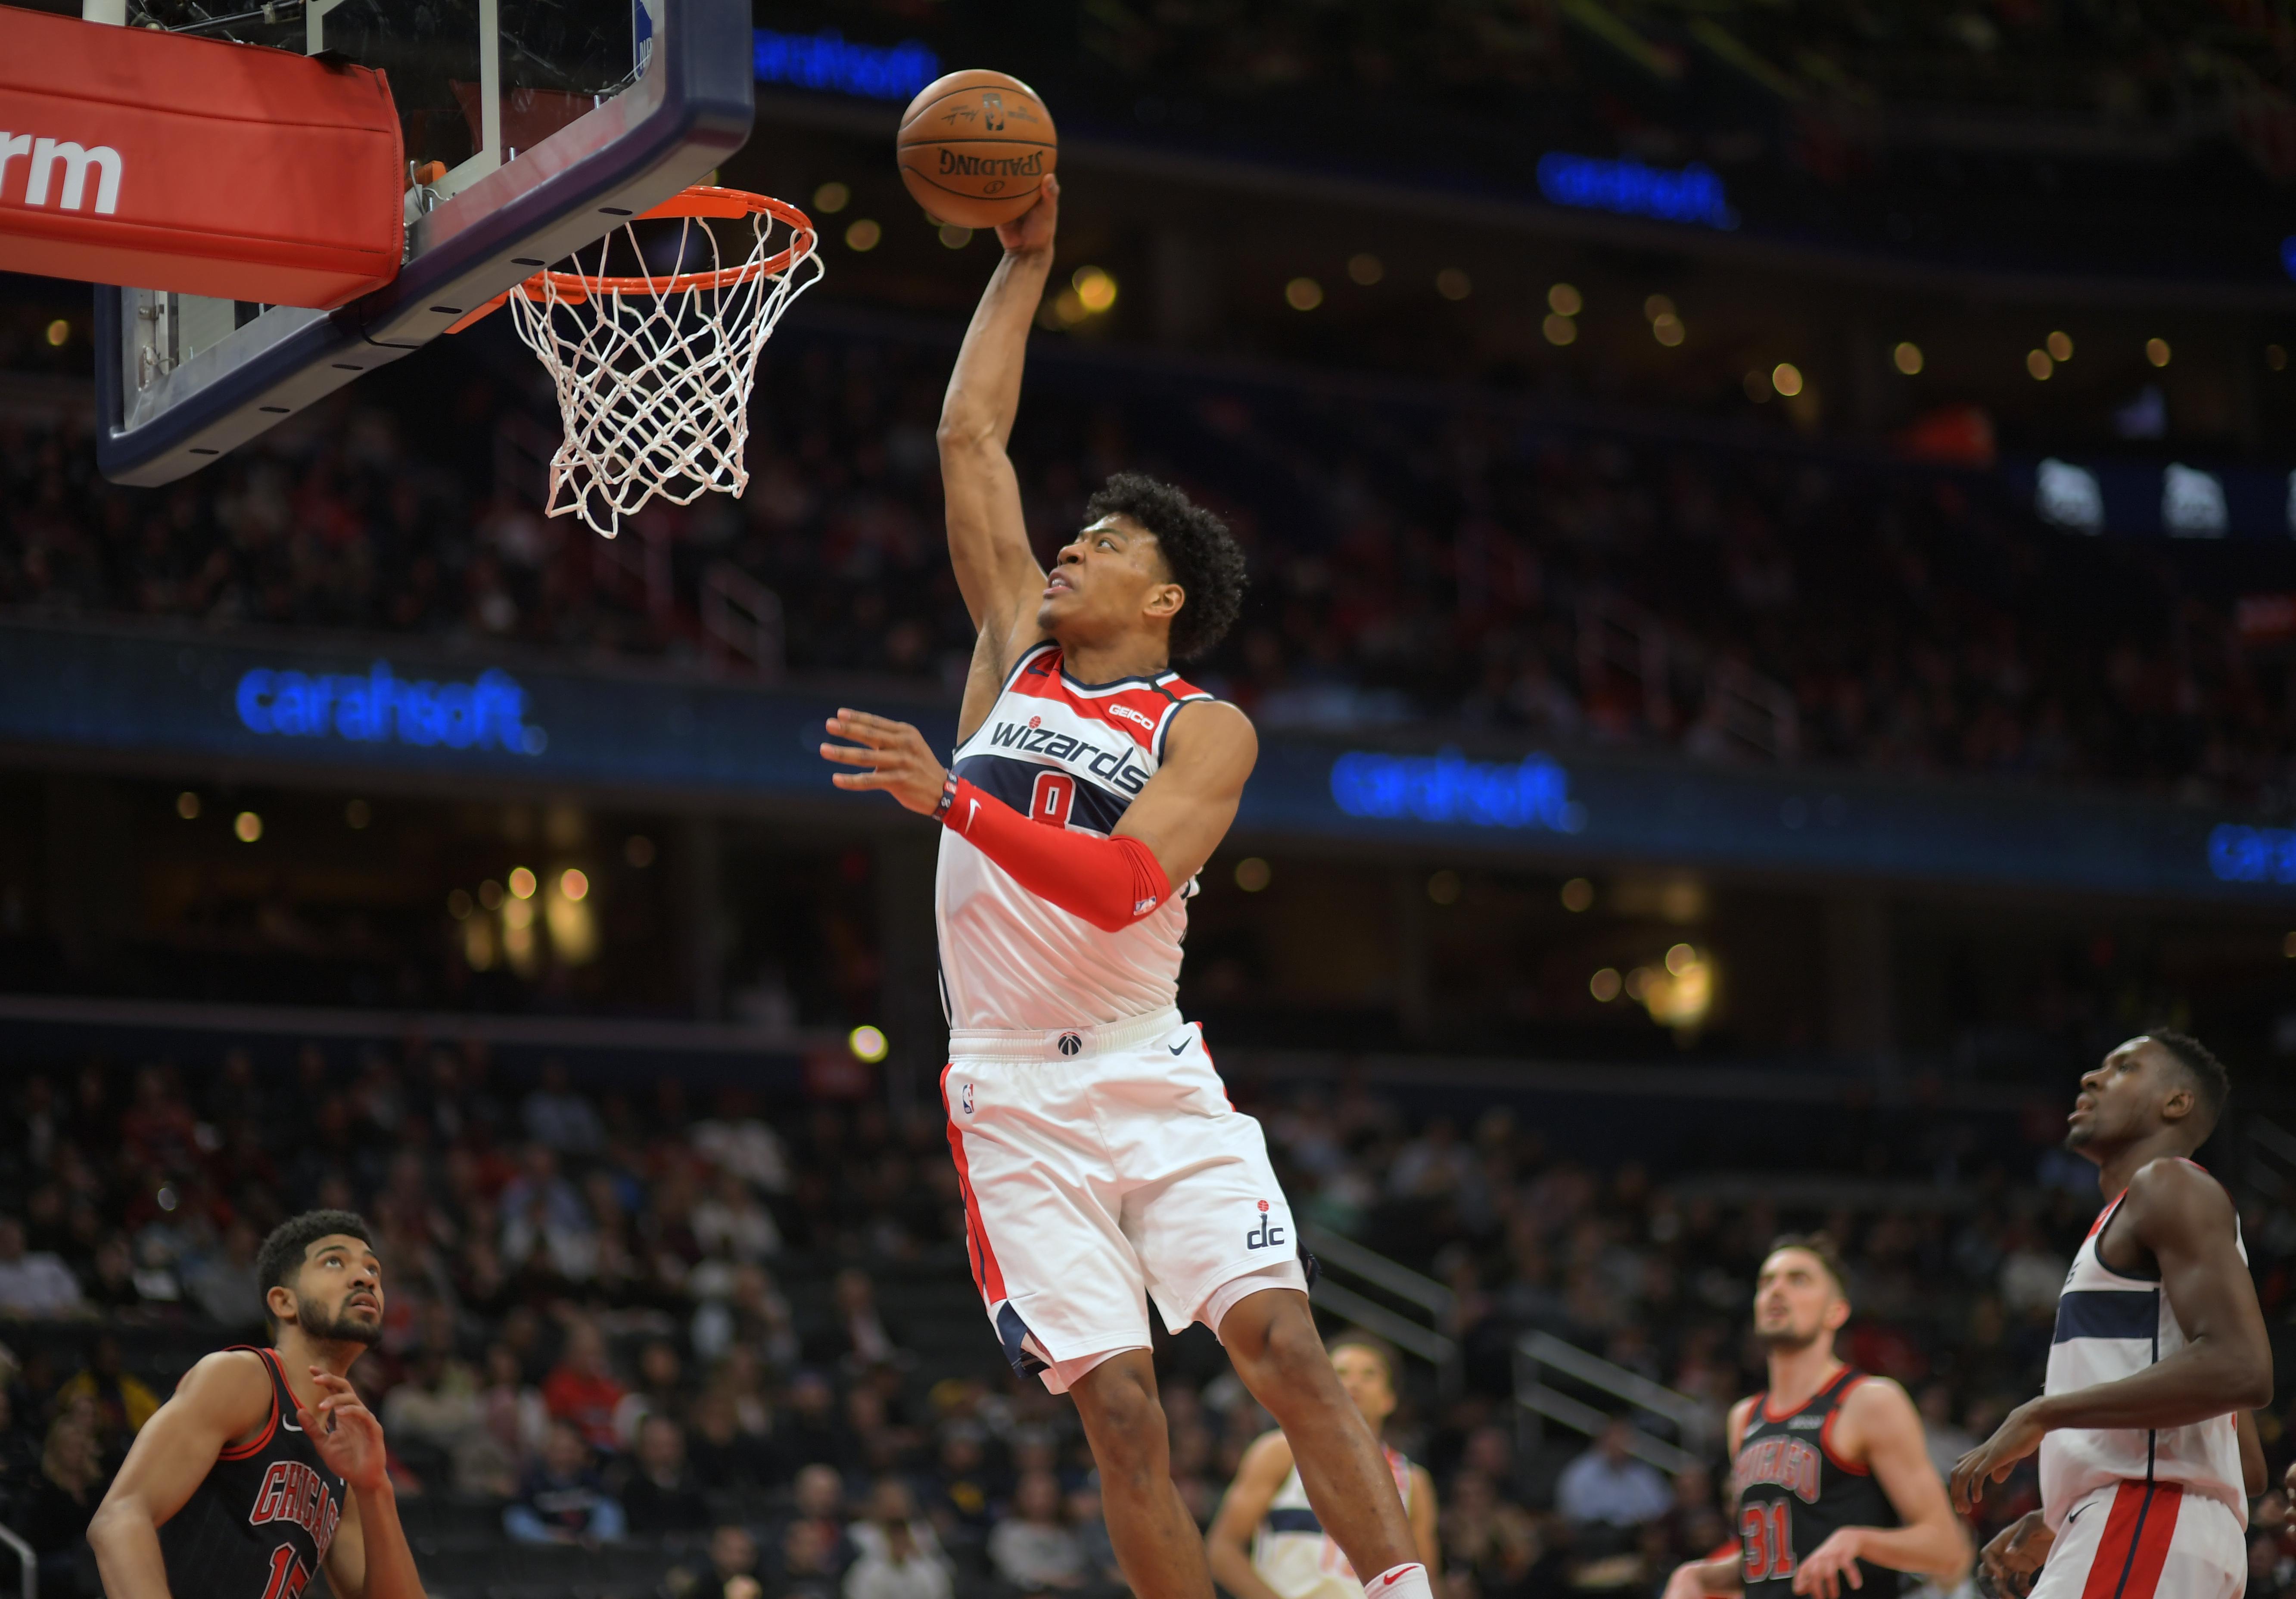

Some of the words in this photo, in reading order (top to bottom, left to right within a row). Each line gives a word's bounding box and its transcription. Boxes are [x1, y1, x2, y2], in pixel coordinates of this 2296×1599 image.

[938, 149, 1043, 176] SPALDING
[236, 658, 525, 755] carahsoft
[1109, 703, 1155, 730] GEICO
[990, 716, 1151, 795] wizards
[1247, 1212, 1285, 1250] dc
[1739, 1498, 1797, 1584] 31
